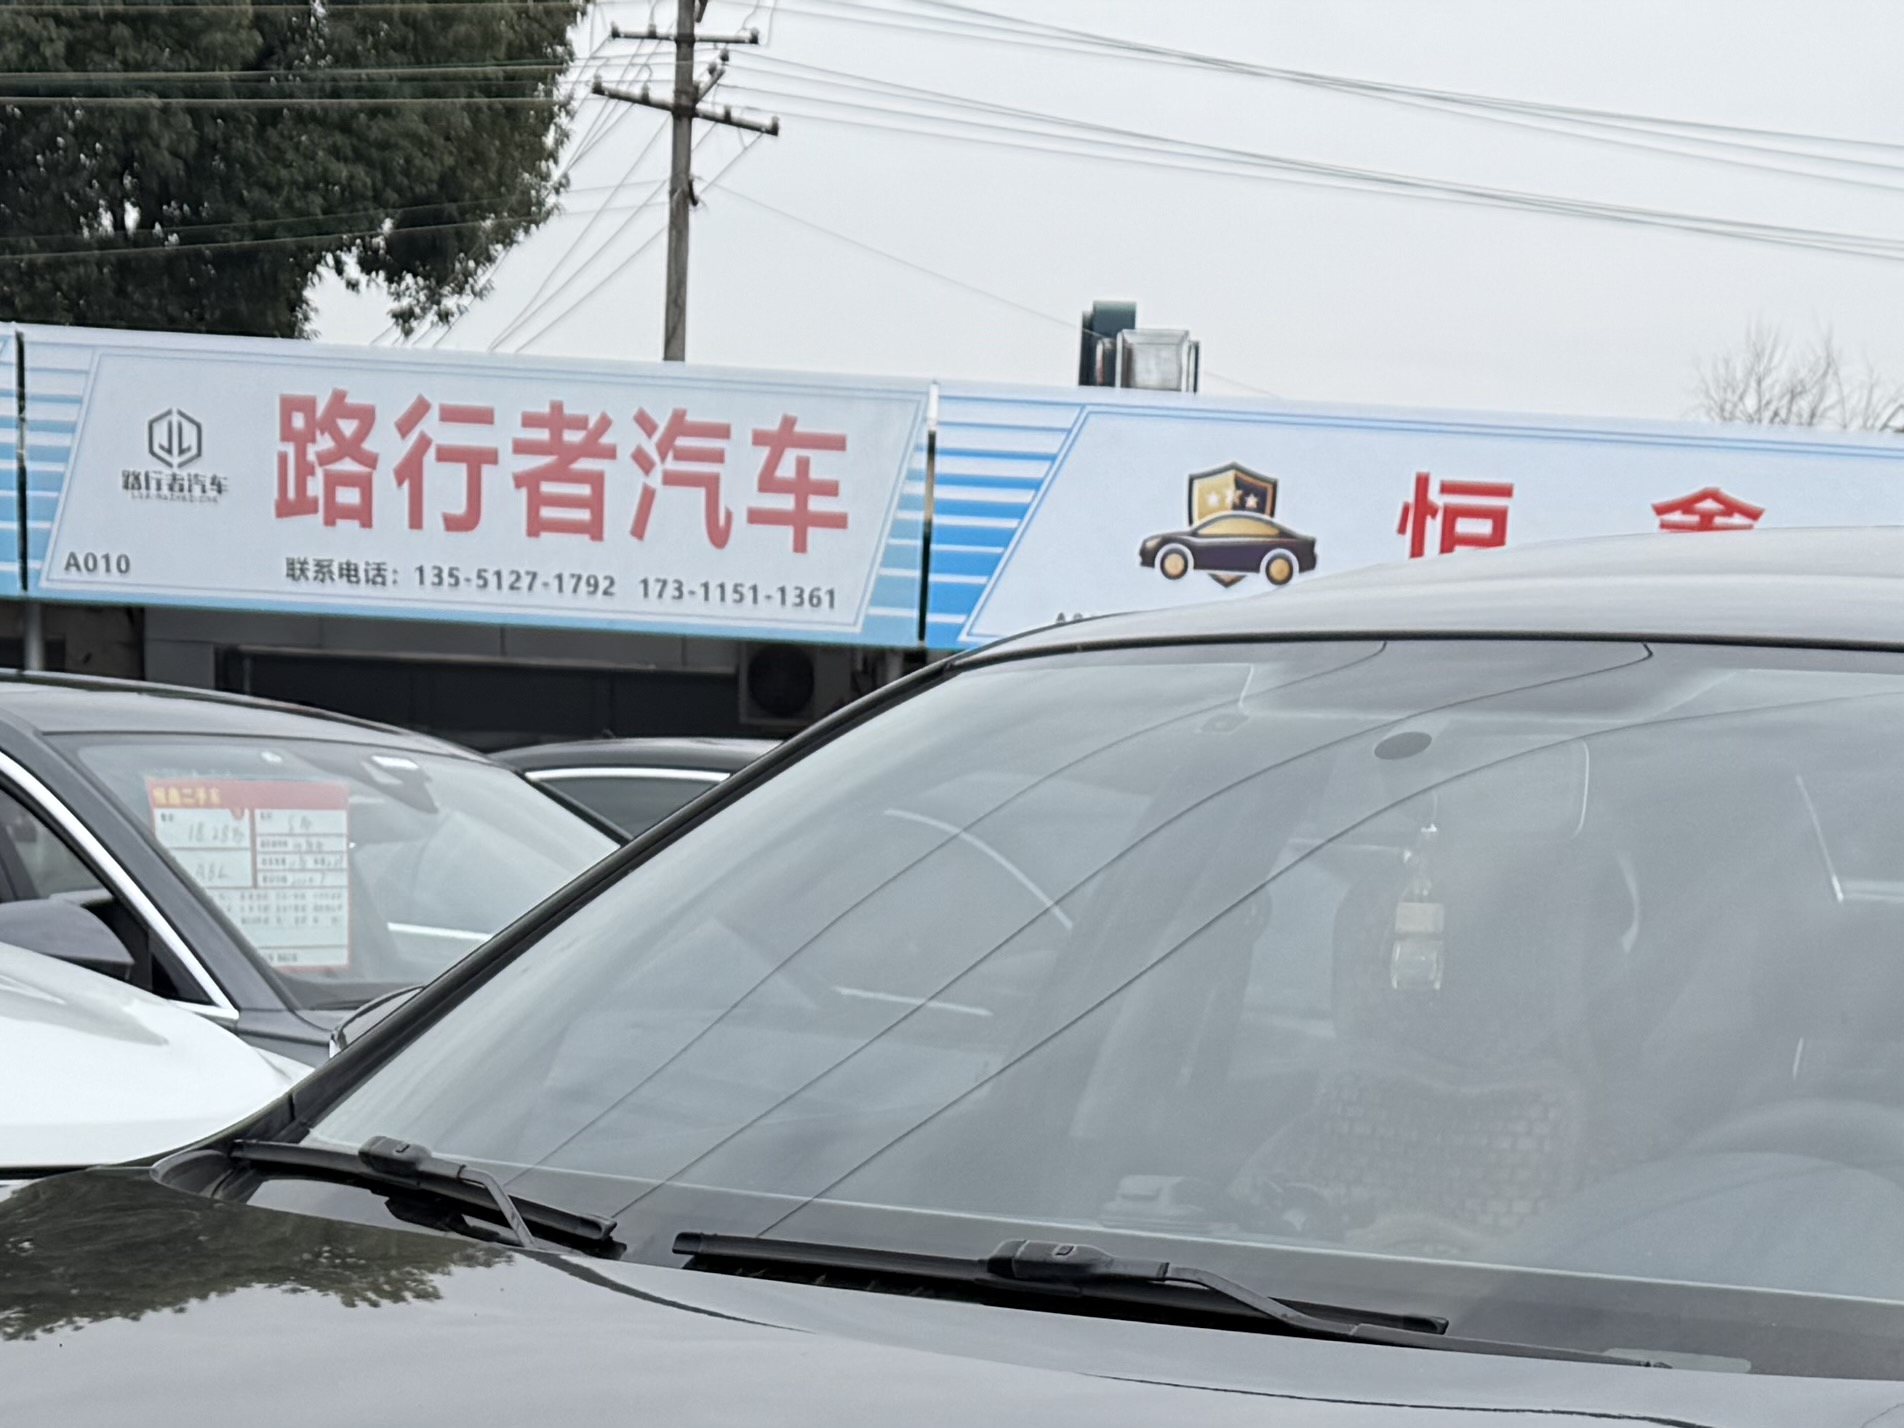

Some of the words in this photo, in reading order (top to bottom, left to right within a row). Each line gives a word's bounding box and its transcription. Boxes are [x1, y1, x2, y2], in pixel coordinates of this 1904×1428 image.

[272, 386, 851, 556] 路行者汽车
[63, 548, 132, 577] A010
[413, 564, 617, 598] 135-5127-1792
[638, 577, 838, 611] 173-1151-1361
